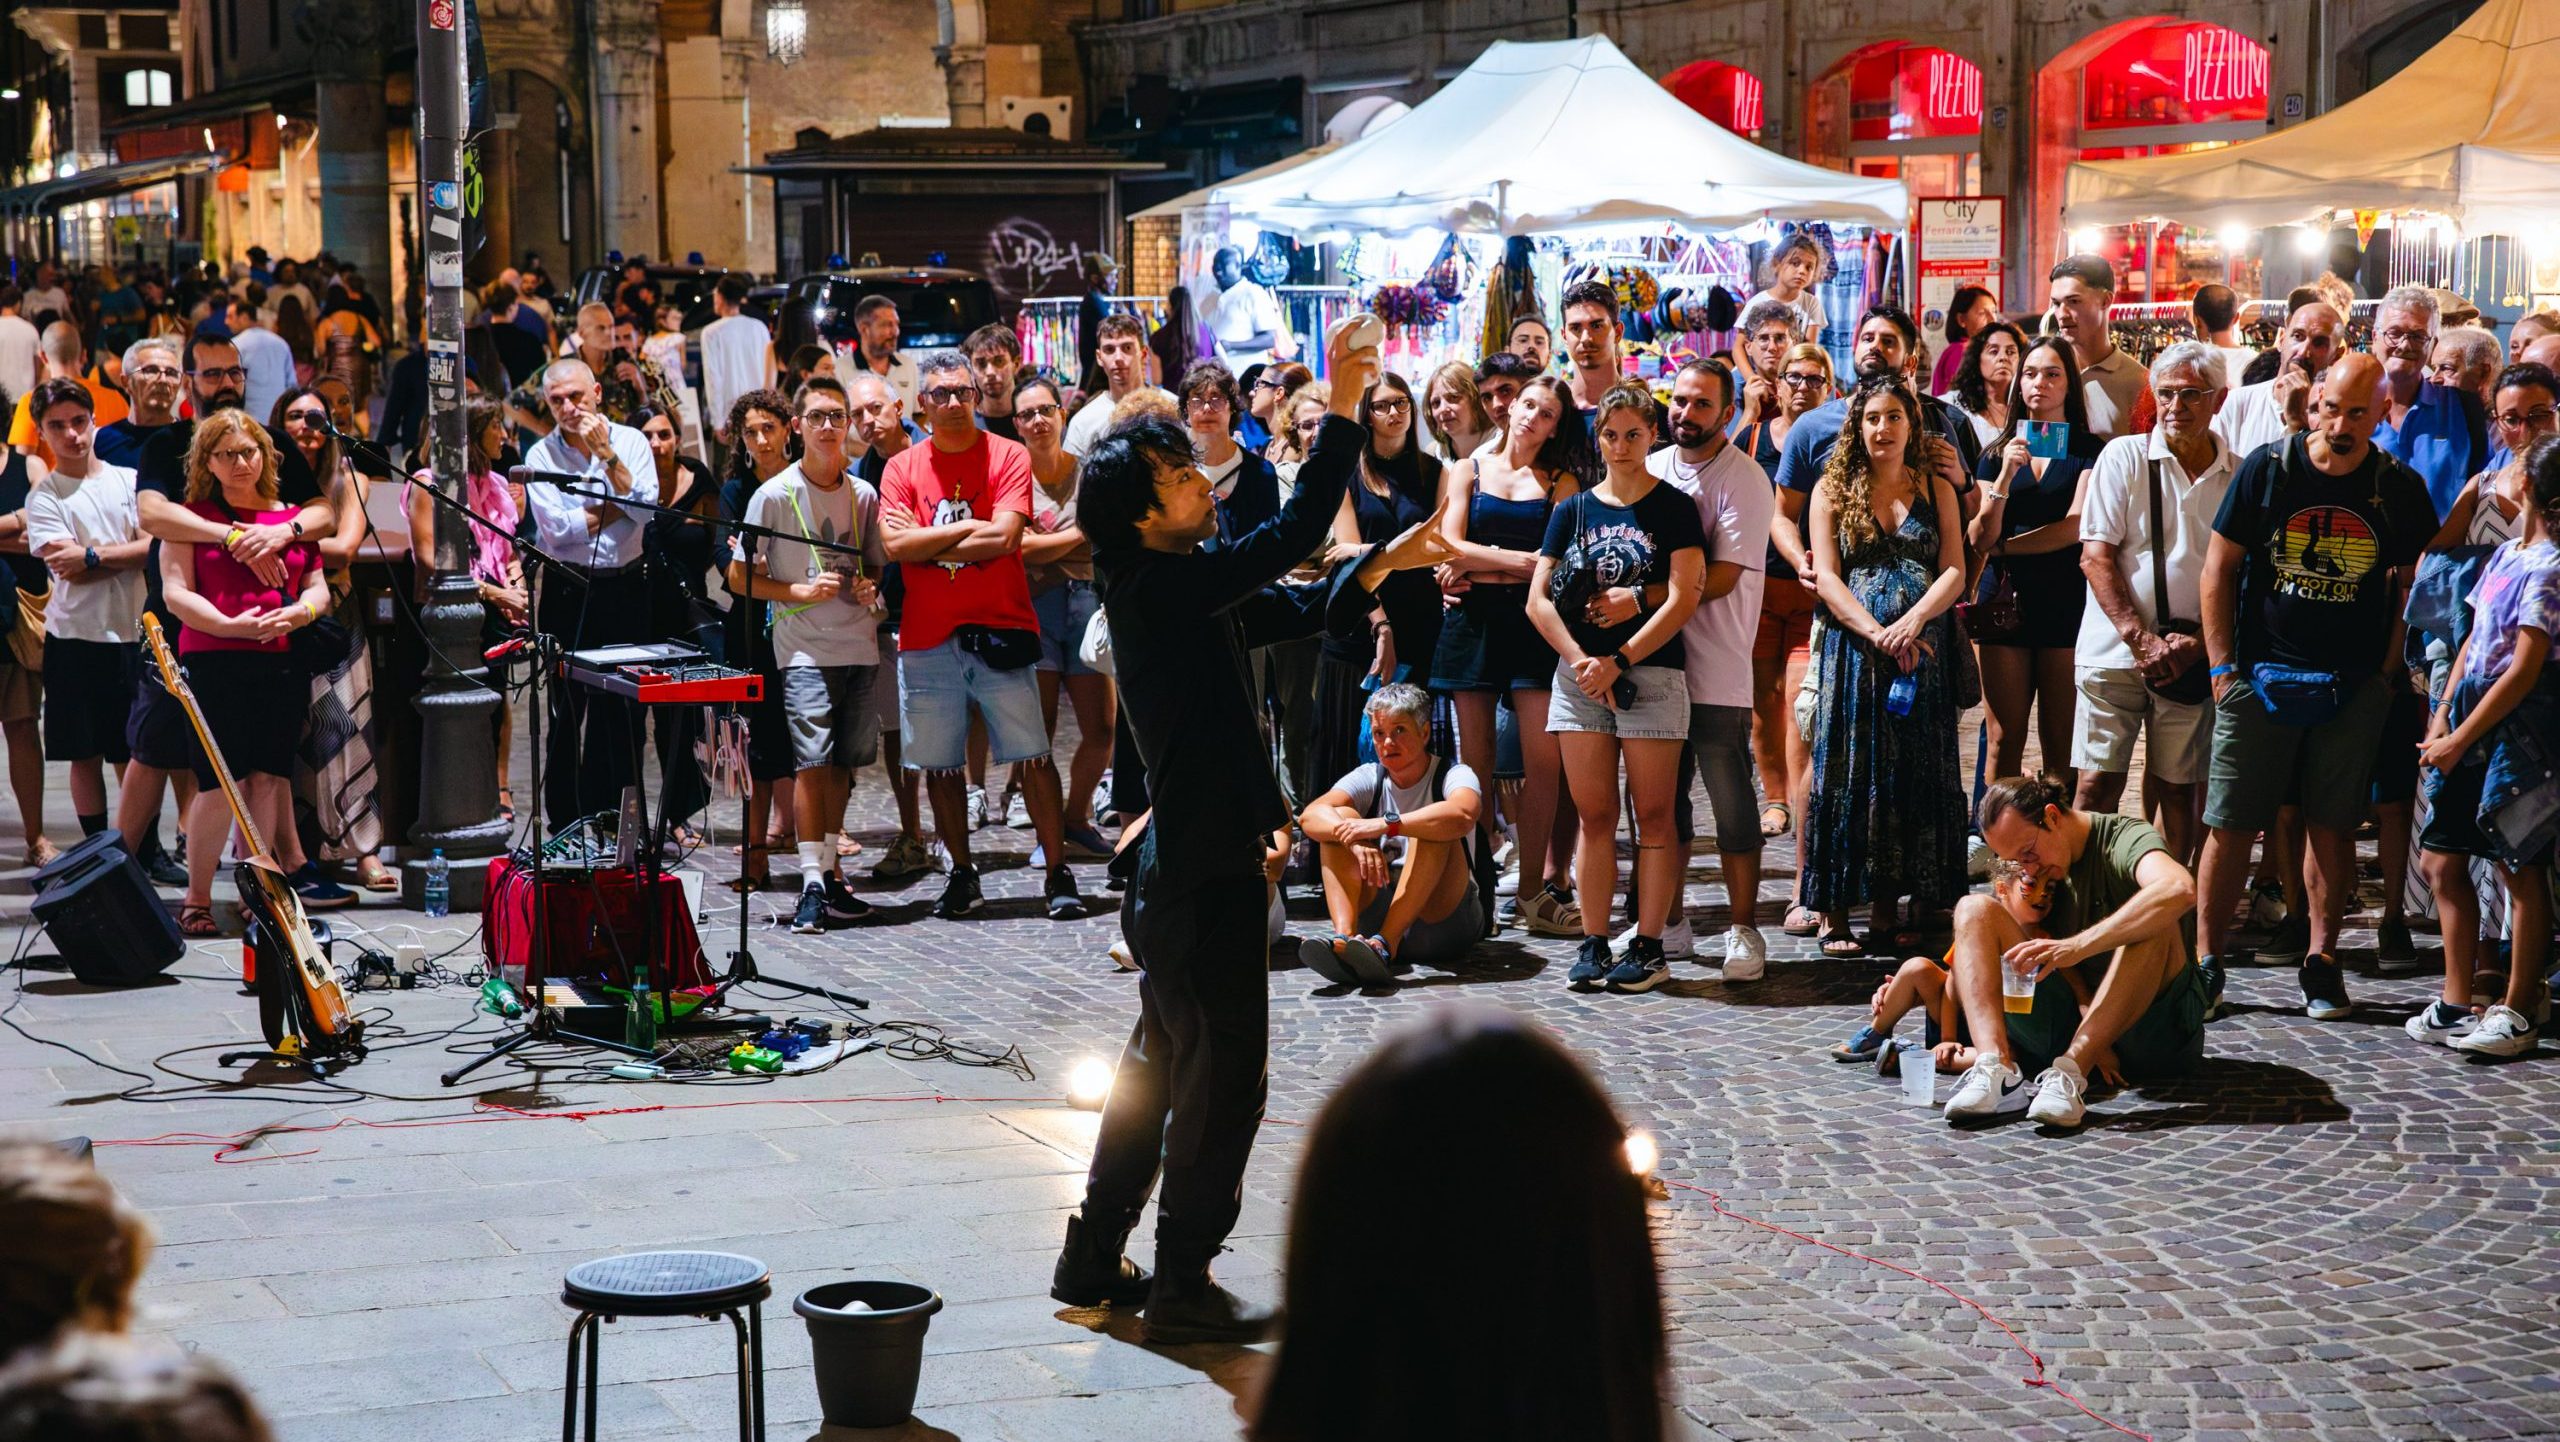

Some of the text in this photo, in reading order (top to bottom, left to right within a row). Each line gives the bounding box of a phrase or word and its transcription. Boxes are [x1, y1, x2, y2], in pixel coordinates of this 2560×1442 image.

[2184, 28, 2268, 103] PIZZIUM
[1943, 199, 1981, 224] City
[1925, 224, 1962, 236] Ferrara
[428, 364, 454, 383] SPAL
[1600, 522, 1657, 554] brigade
[2273, 578, 2296, 596] I'M
